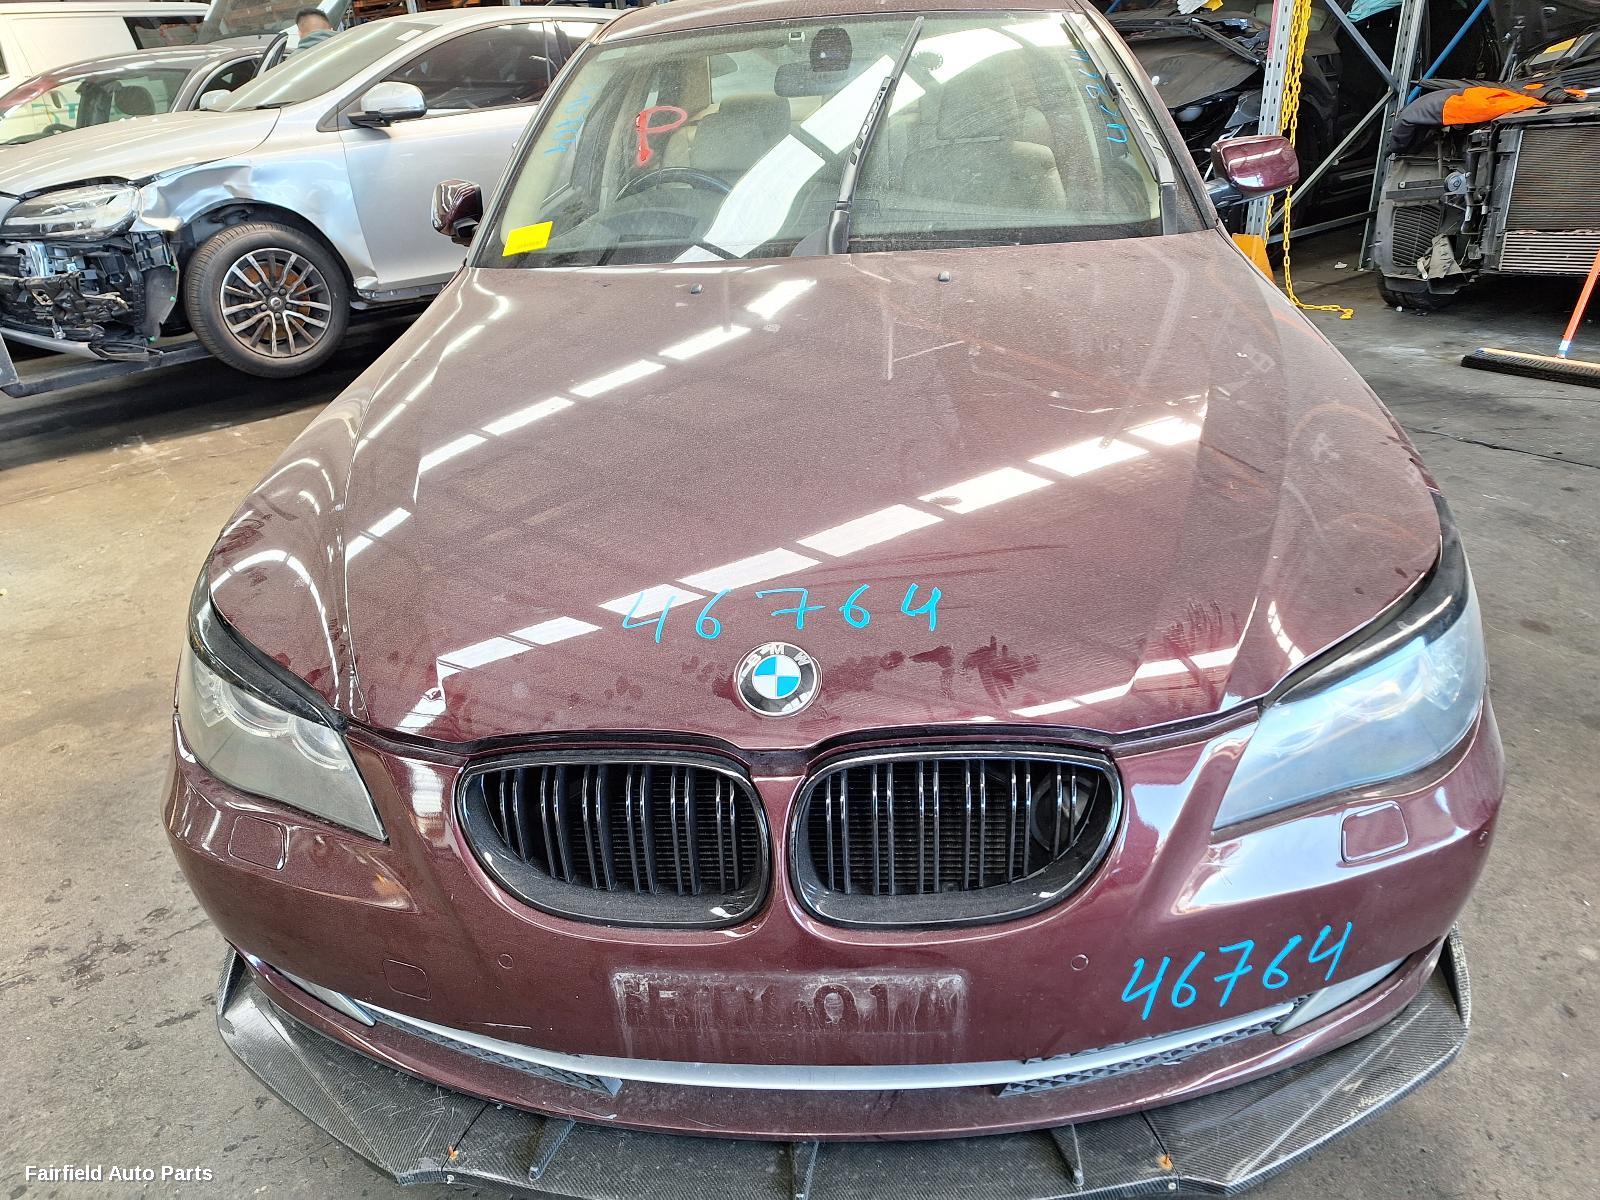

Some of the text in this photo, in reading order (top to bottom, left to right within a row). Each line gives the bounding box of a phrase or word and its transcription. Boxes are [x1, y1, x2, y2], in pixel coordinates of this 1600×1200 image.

[635, 105, 688, 166] P
[622, 583, 942, 643] 46764
[747, 645, 811, 667] BMW
[1121, 921, 1353, 1021] 46764
